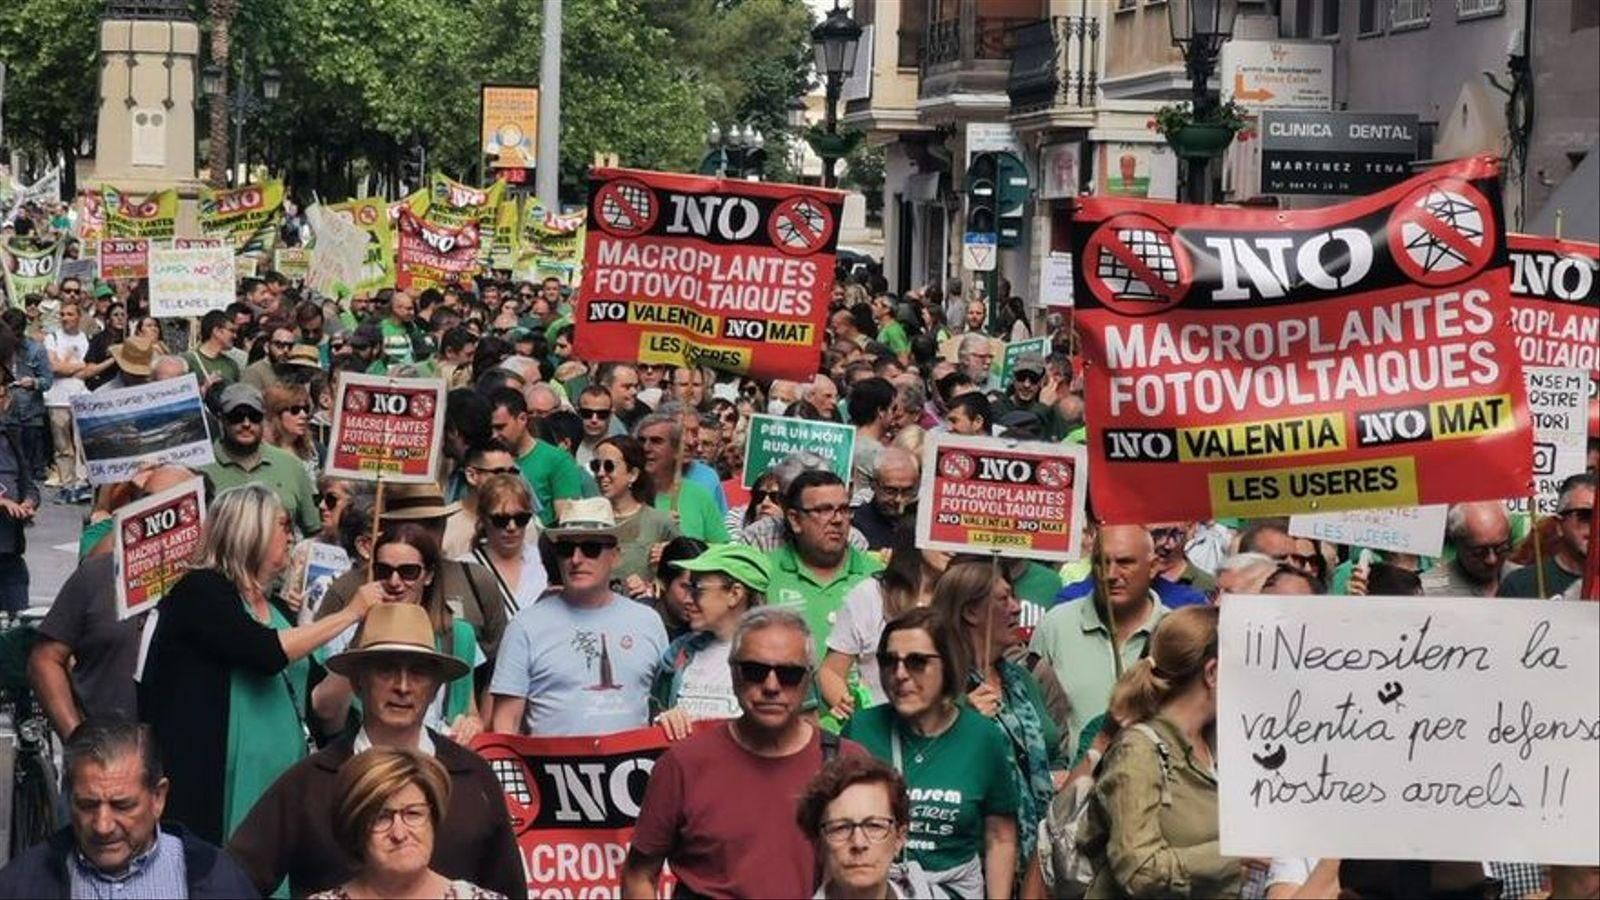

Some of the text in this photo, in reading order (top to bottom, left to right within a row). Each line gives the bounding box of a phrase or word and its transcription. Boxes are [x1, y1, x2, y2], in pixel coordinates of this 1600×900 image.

[1270, 122, 1412, 140] CLINICA DENTAL
[1270, 161, 1404, 173] MARTINEZ TENA
[221, 189, 260, 212] NO
[666, 195, 760, 240] NO
[115, 240, 136, 253] NO
[422, 228, 456, 253] NO
[18, 255, 53, 277] NO
[597, 240, 816, 288] MACROPLANTES
[1205, 227, 1374, 300] NO
[1509, 254, 1593, 300] NO
[594, 269, 812, 317] FOTOVOLTAIQUES
[588, 302, 810, 342] NO VALENTIA NO MAT
[1105, 290, 1495, 370] MACROPLANTES
[650, 336, 741, 366] LES USERES
[1109, 341, 1499, 417] FOTOVOLTAIQUES
[1523, 372, 1581, 390] NSEM
[372, 393, 408, 415] NO
[1529, 391, 1578, 408] OSTRE
[346, 416, 429, 433] MACROLANTES
[761, 424, 844, 444] PER UN MÓN
[1107, 399, 1504, 460] NO VALENTIA NO MAT
[343, 429, 429, 447] FOTOVOTAIQUES
[979, 457, 1031, 483] NO
[942, 482, 1066, 506] MACROPLANTES
[1227, 466, 1398, 501] LES USERES
[940, 497, 1064, 521] FOTOVOLTAIQUES
[145, 508, 176, 538] NO
[938, 514, 1064, 533] NO VALENTIA NO MAT
[1313, 522, 1343, 540] LES
[127, 525, 199, 561] MACROLANTES
[973, 531, 991, 544] LES
[1521, 620, 1568, 669] la
[1242, 689, 1396, 744] valentia
[1408, 717, 1467, 762] per
[544, 758, 655, 821] NO
[1251, 752, 1386, 808] nostres
[1402, 763, 1525, 809] arrels
[906, 788, 962, 804] nsem
[909, 822, 954, 836] ELS
[519, 841, 630, 884] CROP
